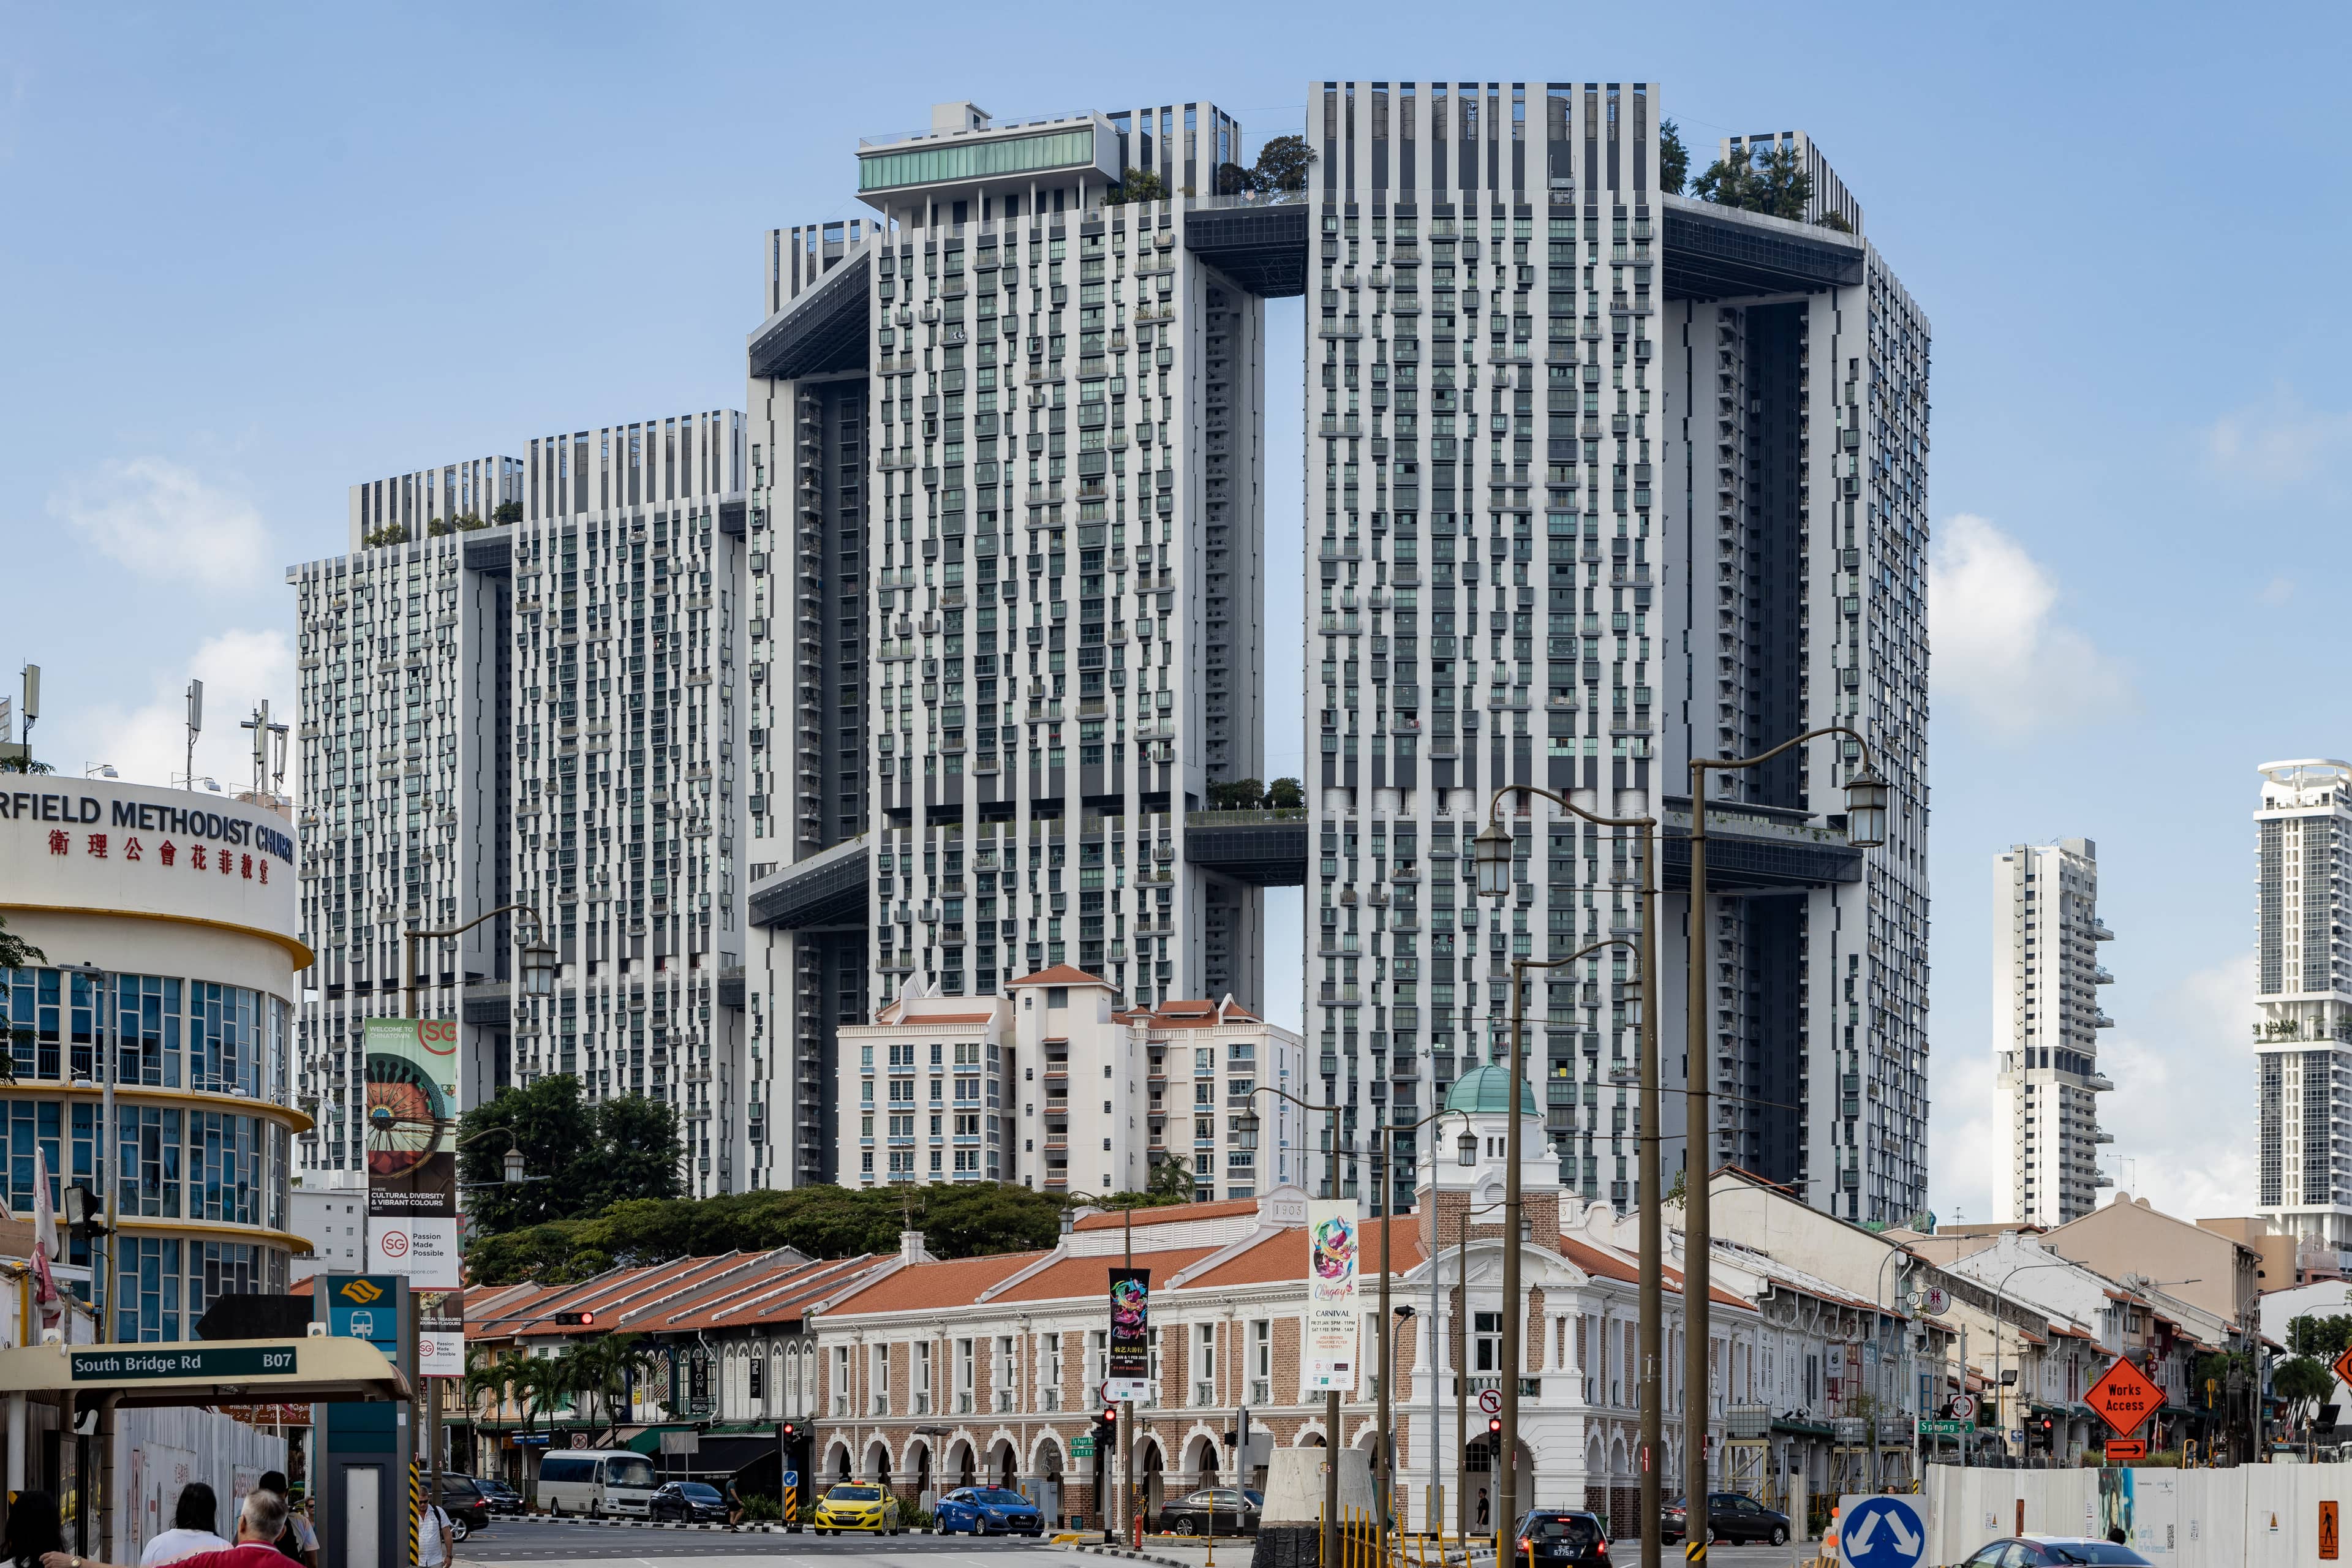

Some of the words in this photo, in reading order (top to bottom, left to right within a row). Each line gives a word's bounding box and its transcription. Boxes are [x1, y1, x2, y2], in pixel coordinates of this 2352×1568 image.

[113, 800, 253, 846] METHODIST
[256, 825, 293, 866] CHURCH
[48, 829, 268, 884] 衛理公會花菲教堂
[425, 1022, 456, 1041] SG
[1276, 1205, 1302, 1215] 1903
[386, 1238, 405, 1250] SG
[1909, 1294, 1917, 1303] 17
[75, 1357, 119, 1372] South
[125, 1355, 176, 1373] Bridge
[181, 1354, 201, 1369] Rd
[263, 1354, 292, 1367] B07
[695, 1373, 704, 1396] OWL
[2108, 1383, 2141, 1396] Works
[2106, 1399, 2144, 1411] Access
[478, 1449, 483, 1459] 30
